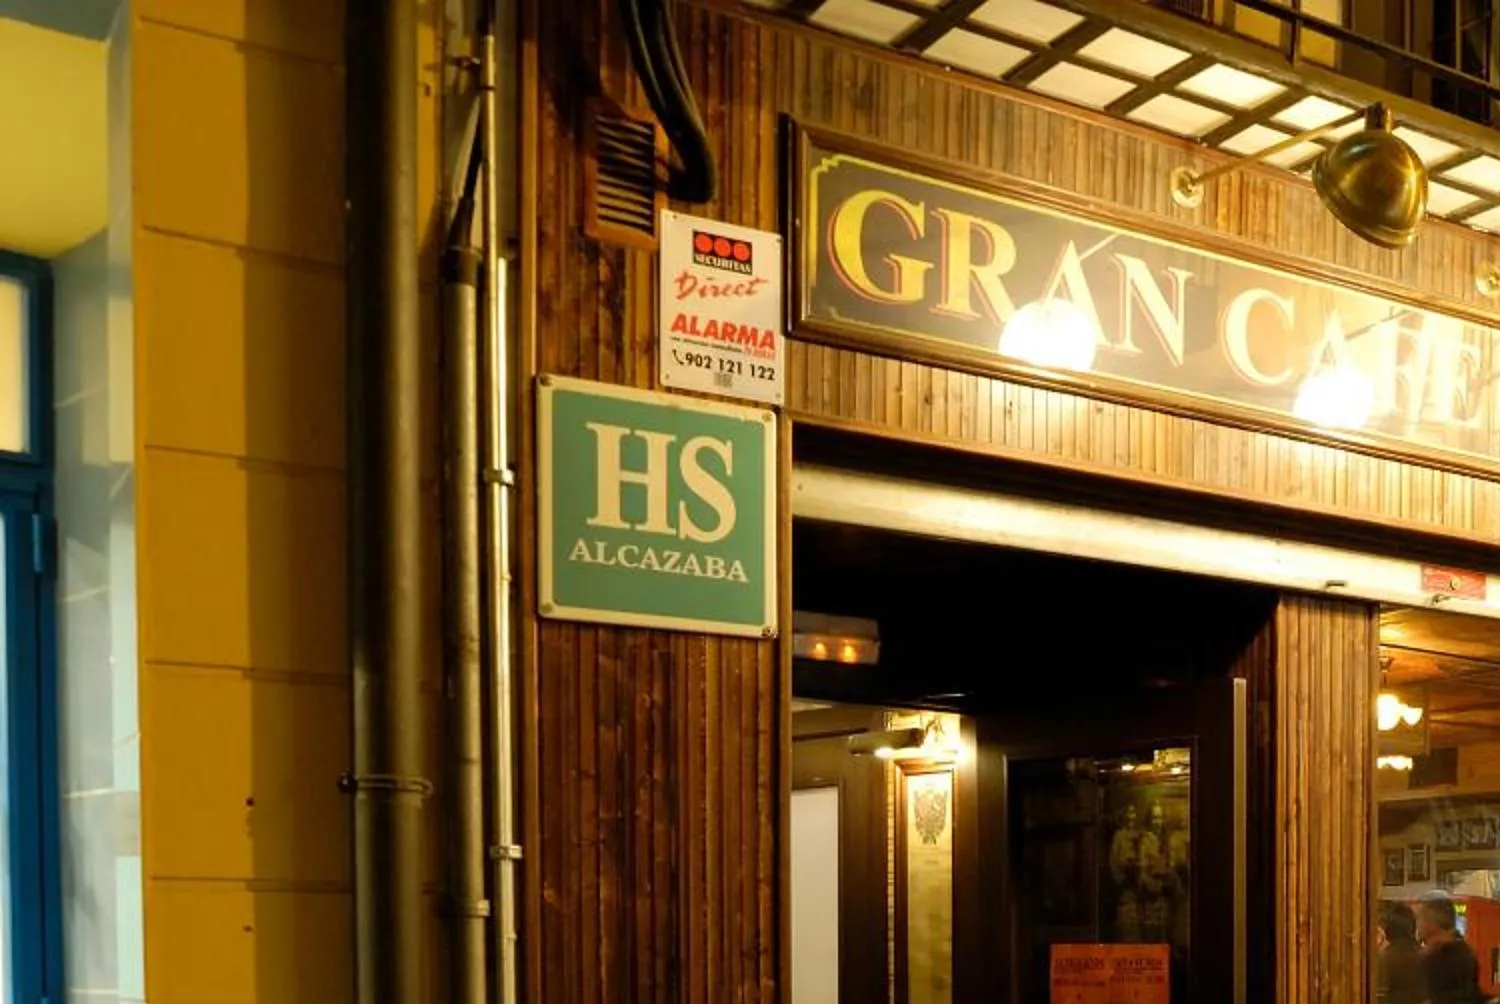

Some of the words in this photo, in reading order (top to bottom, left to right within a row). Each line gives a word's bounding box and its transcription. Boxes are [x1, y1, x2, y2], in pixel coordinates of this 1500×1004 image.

[673, 269, 769, 301] Direct
[828, 189, 1194, 368] GRAN
[670, 312, 776, 350] ALARMA
[684, 350, 713, 370] 902
[718, 357, 742, 375] 121
[749, 364, 776, 381] 122
[585, 421, 737, 544] HS
[568, 537, 750, 584] ALCAZABA
